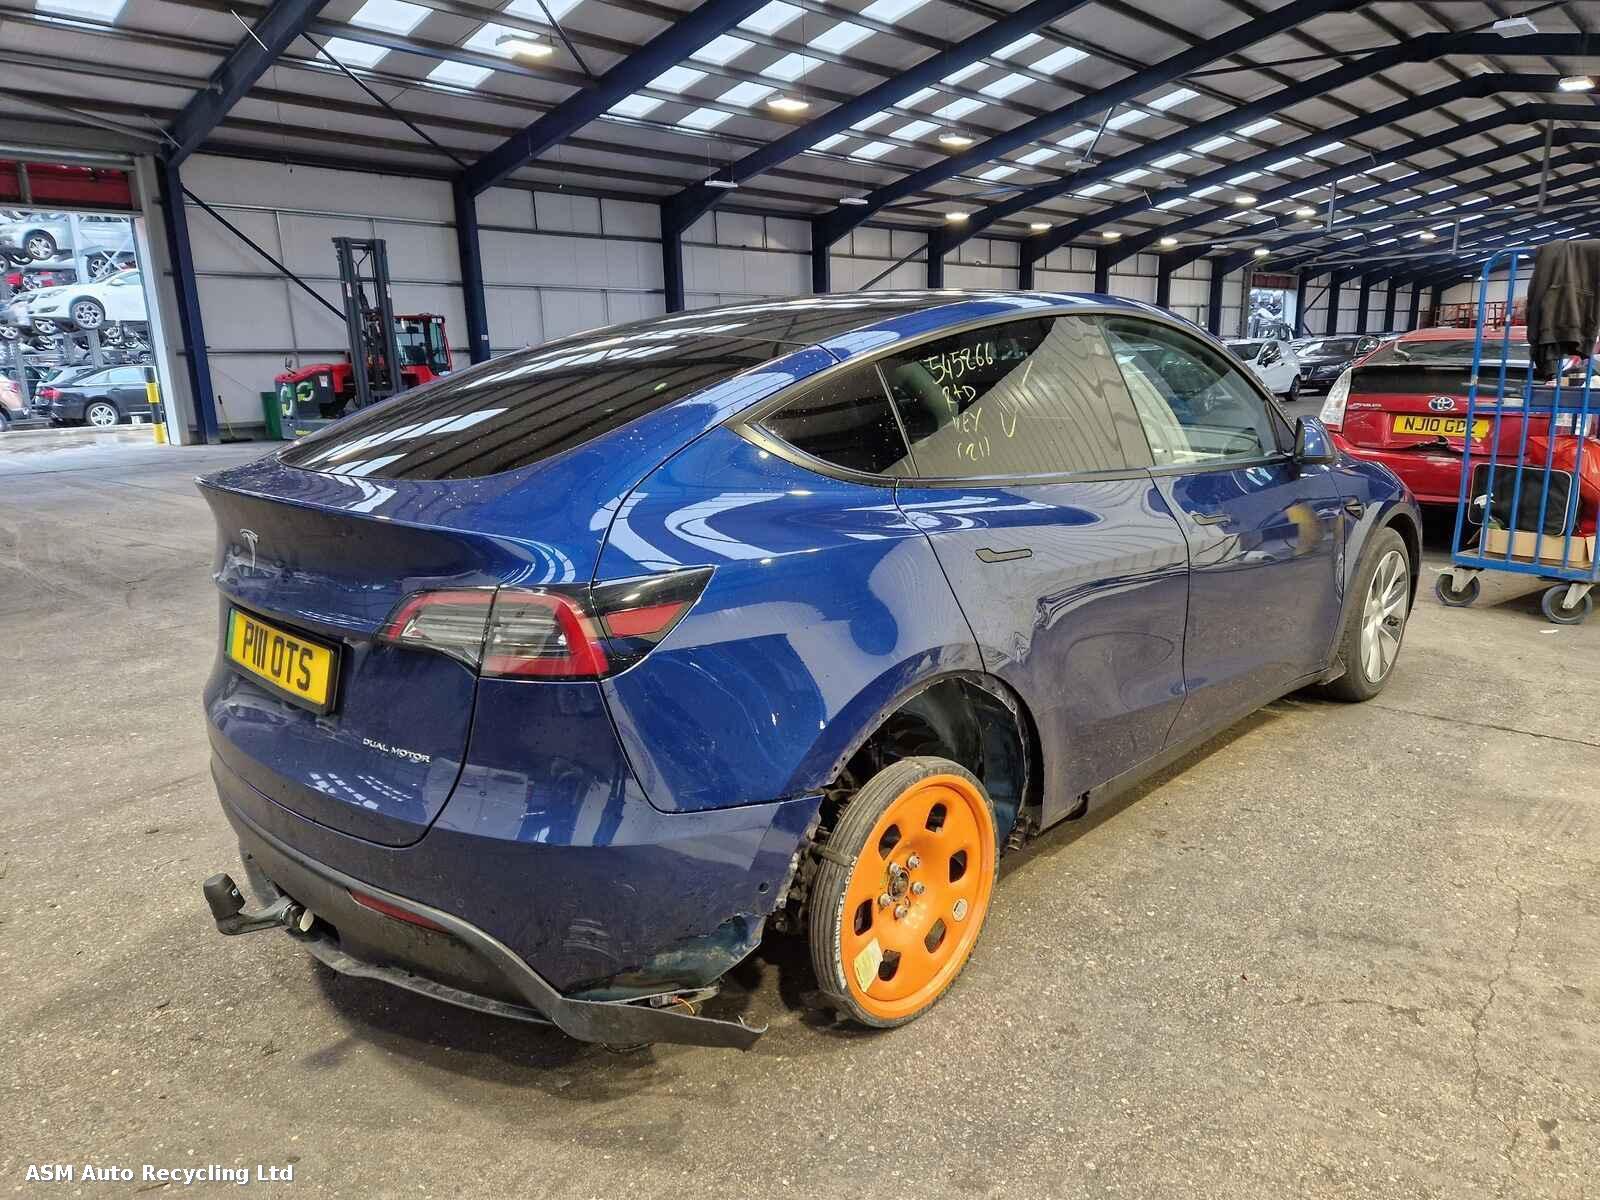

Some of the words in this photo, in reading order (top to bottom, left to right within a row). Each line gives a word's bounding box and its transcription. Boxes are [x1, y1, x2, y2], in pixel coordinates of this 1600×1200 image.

[1404, 417, 1440, 431] NJ10
[242, 620, 268, 670] P111
[271, 635, 313, 691] OTS
[362, 738, 389, 752] DUAL
[391, 746, 431, 763] MOTOR
